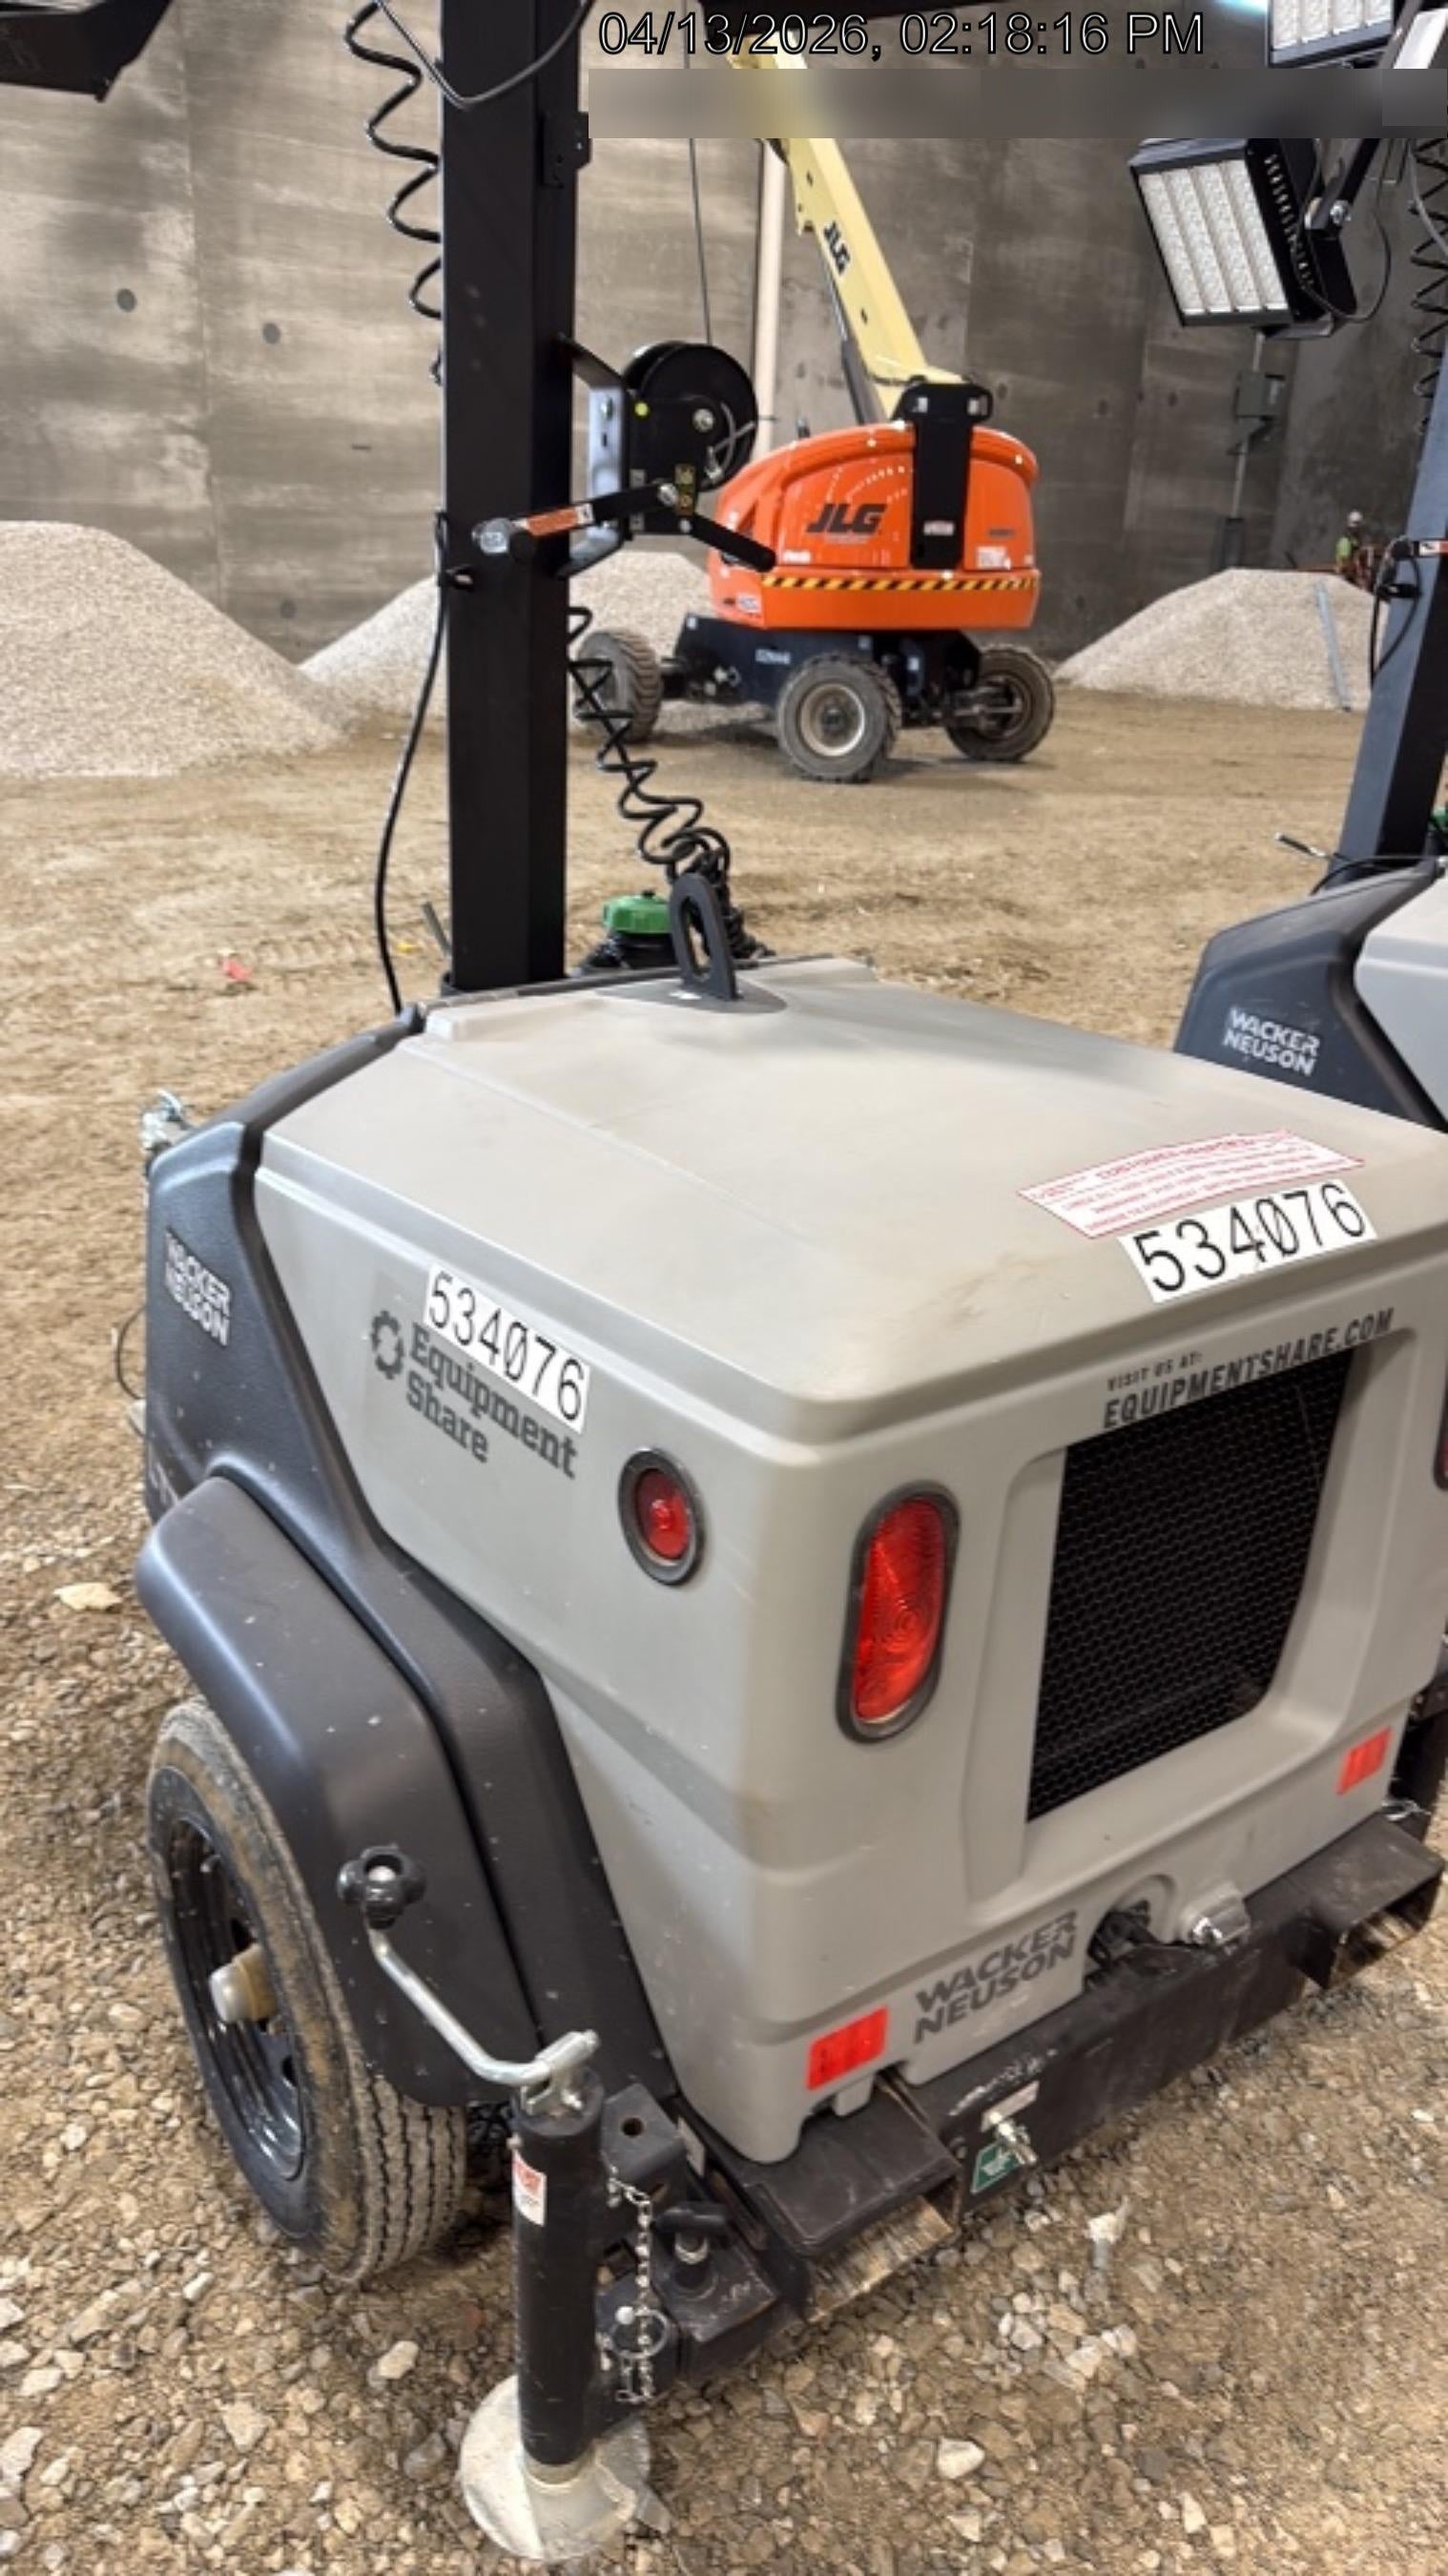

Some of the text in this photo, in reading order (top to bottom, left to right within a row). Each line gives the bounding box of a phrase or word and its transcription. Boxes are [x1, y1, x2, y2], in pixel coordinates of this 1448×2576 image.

[823, 219, 851, 276] JLG
[806, 503, 887, 534] JLG
[1222, 1028, 1317, 1076] NEUSON
[1229, 1007, 1320, 1057] WACKER
[1132, 1183, 1366, 1292] 534076
[429, 1270, 584, 1422] 534076
[1103, 1306, 1395, 1429] EQUIPMENTSHARE.COM
[405, 1369, 487, 1464] Share
[408, 1320, 578, 1480] Equipment
[913, 1933, 1076, 2045] NEUSON
[916, 1909, 1077, 2013] WACKER
